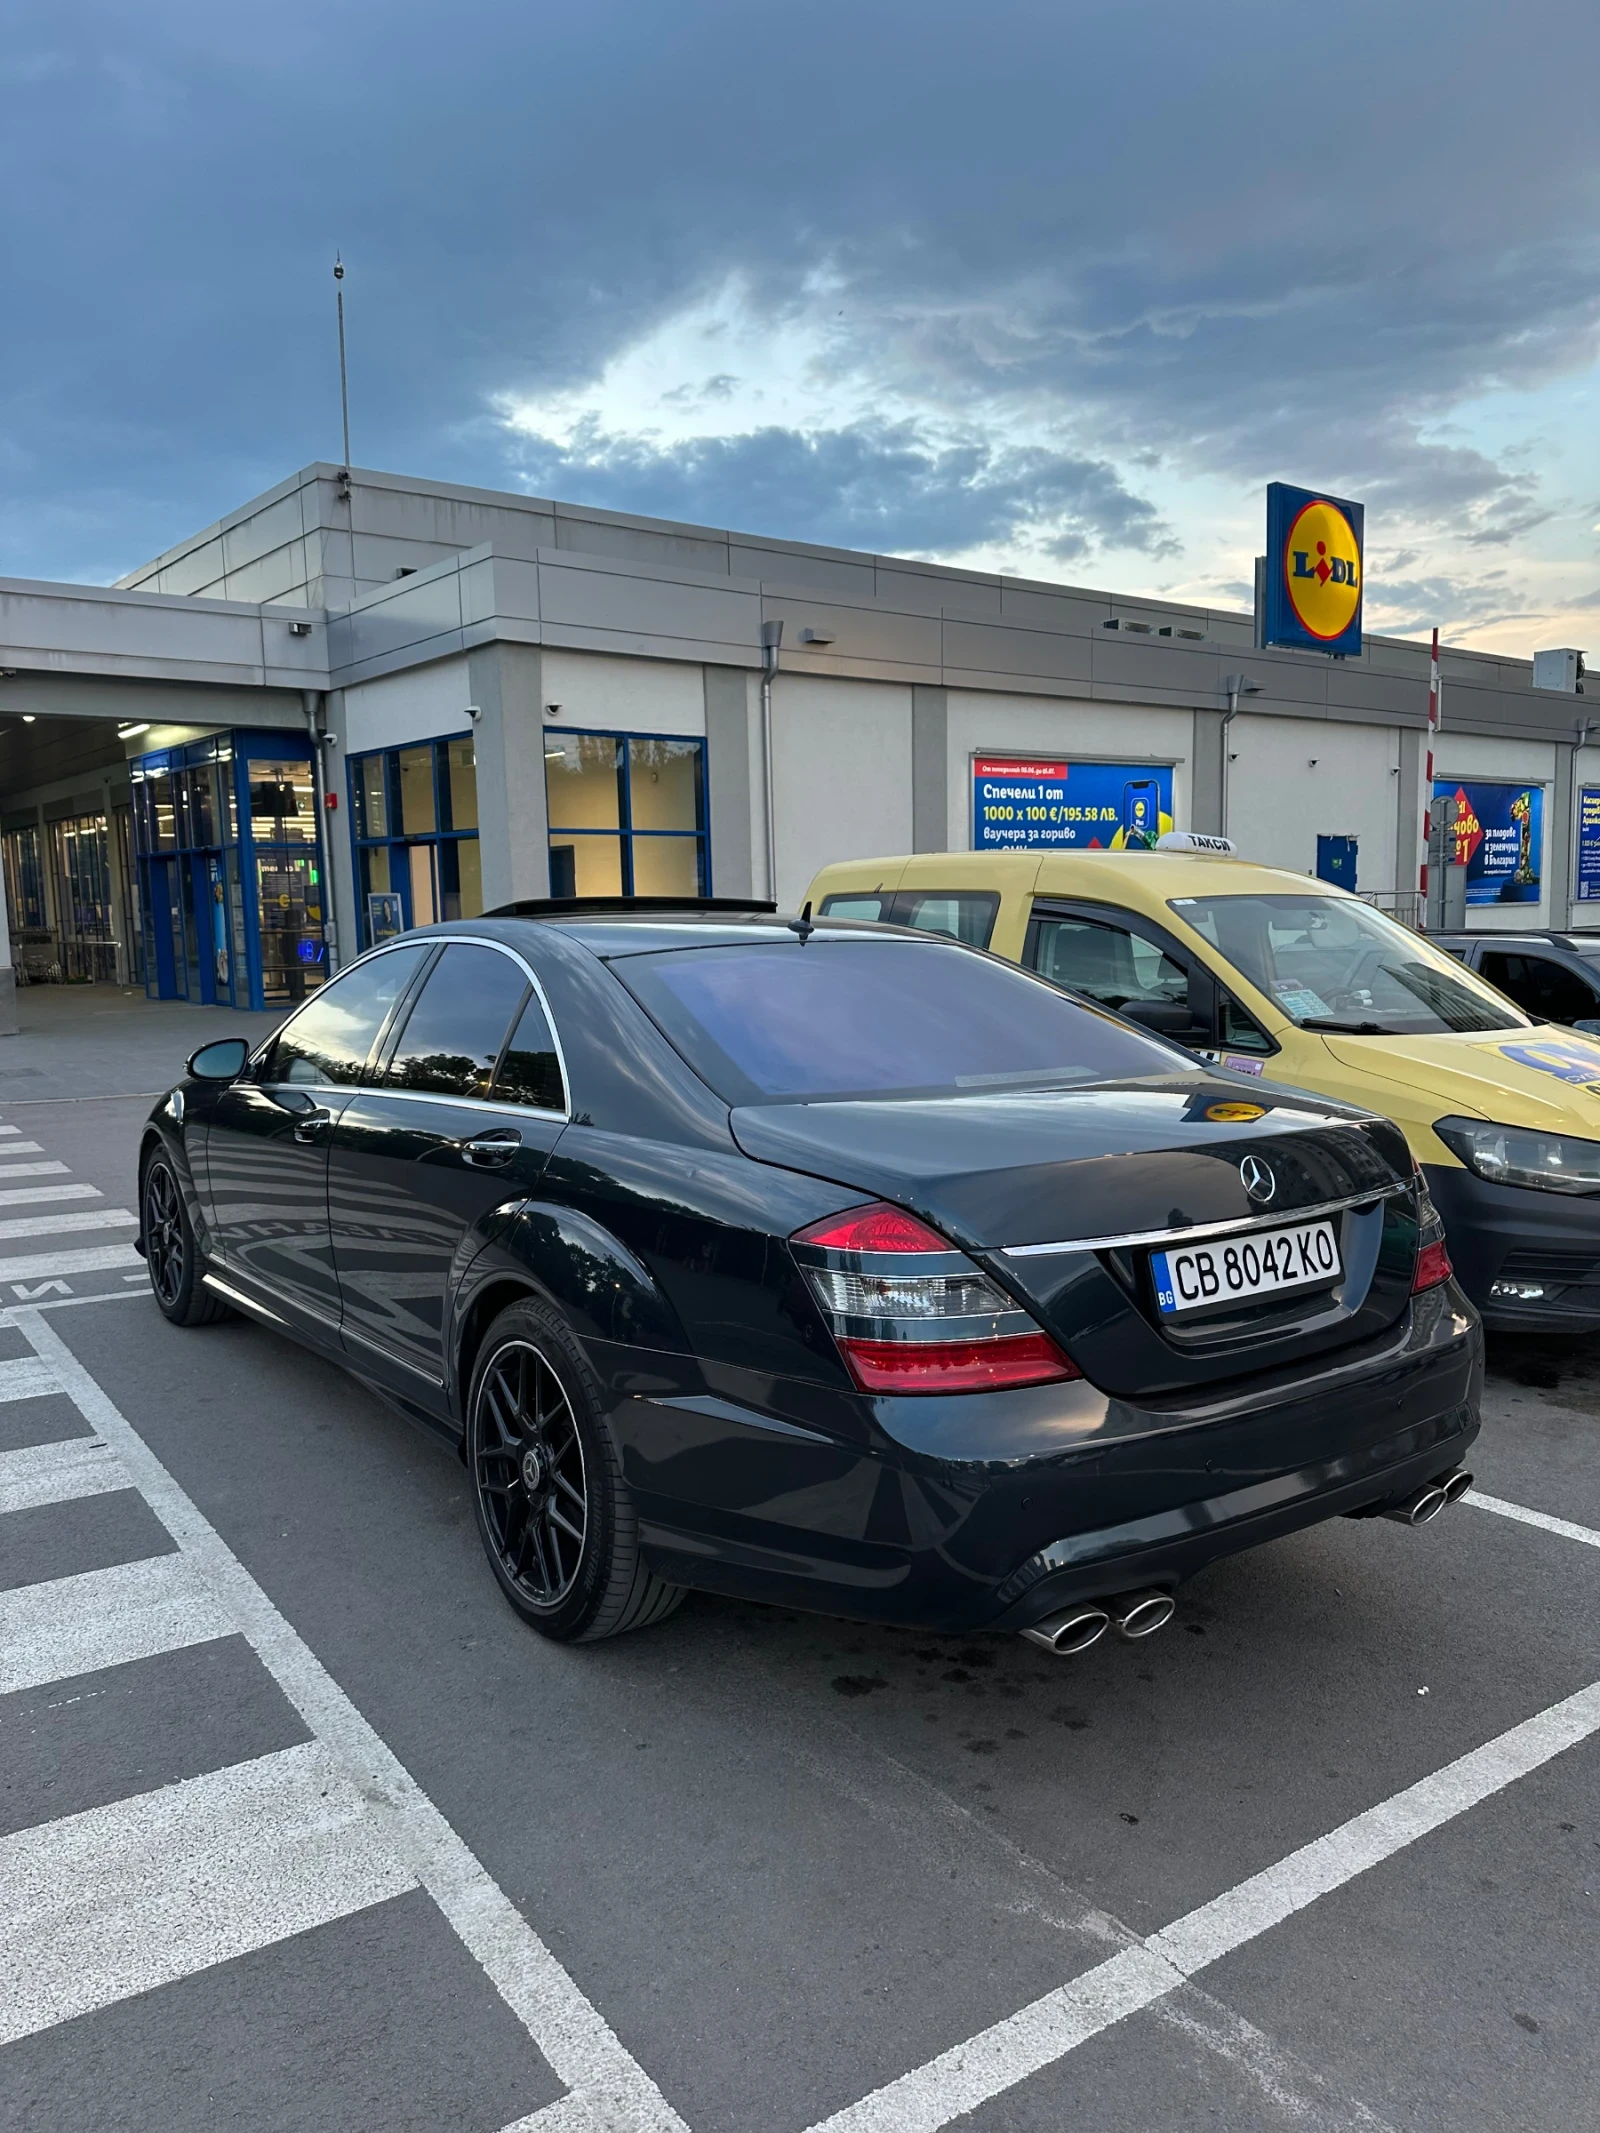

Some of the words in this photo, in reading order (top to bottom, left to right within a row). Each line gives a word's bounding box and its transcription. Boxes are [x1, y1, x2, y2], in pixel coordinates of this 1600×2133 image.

[983, 784, 1036, 799] Спечели
[1038, 785, 1044, 799] 1
[1045, 788, 1063, 800] от
[983, 806, 1014, 821] 1000
[1025, 806, 1047, 821] 100
[1049, 805, 1098, 824] €/195.58
[1100, 807, 1118, 821] ЛВ.
[983, 826, 1026, 842] ваучера
[1027, 830, 1039, 841] за
[1040, 827, 1076, 842] гориво
[1188, 835, 1231, 851] ТАКСИ
[1175, 1251, 1220, 1300] CB
[1223, 1236, 1298, 1290] 8042
[1296, 1228, 1334, 1276] KO
[1158, 1290, 1174, 1306] BG
[582, 1480, 602, 1595] BRIDGESTONE
